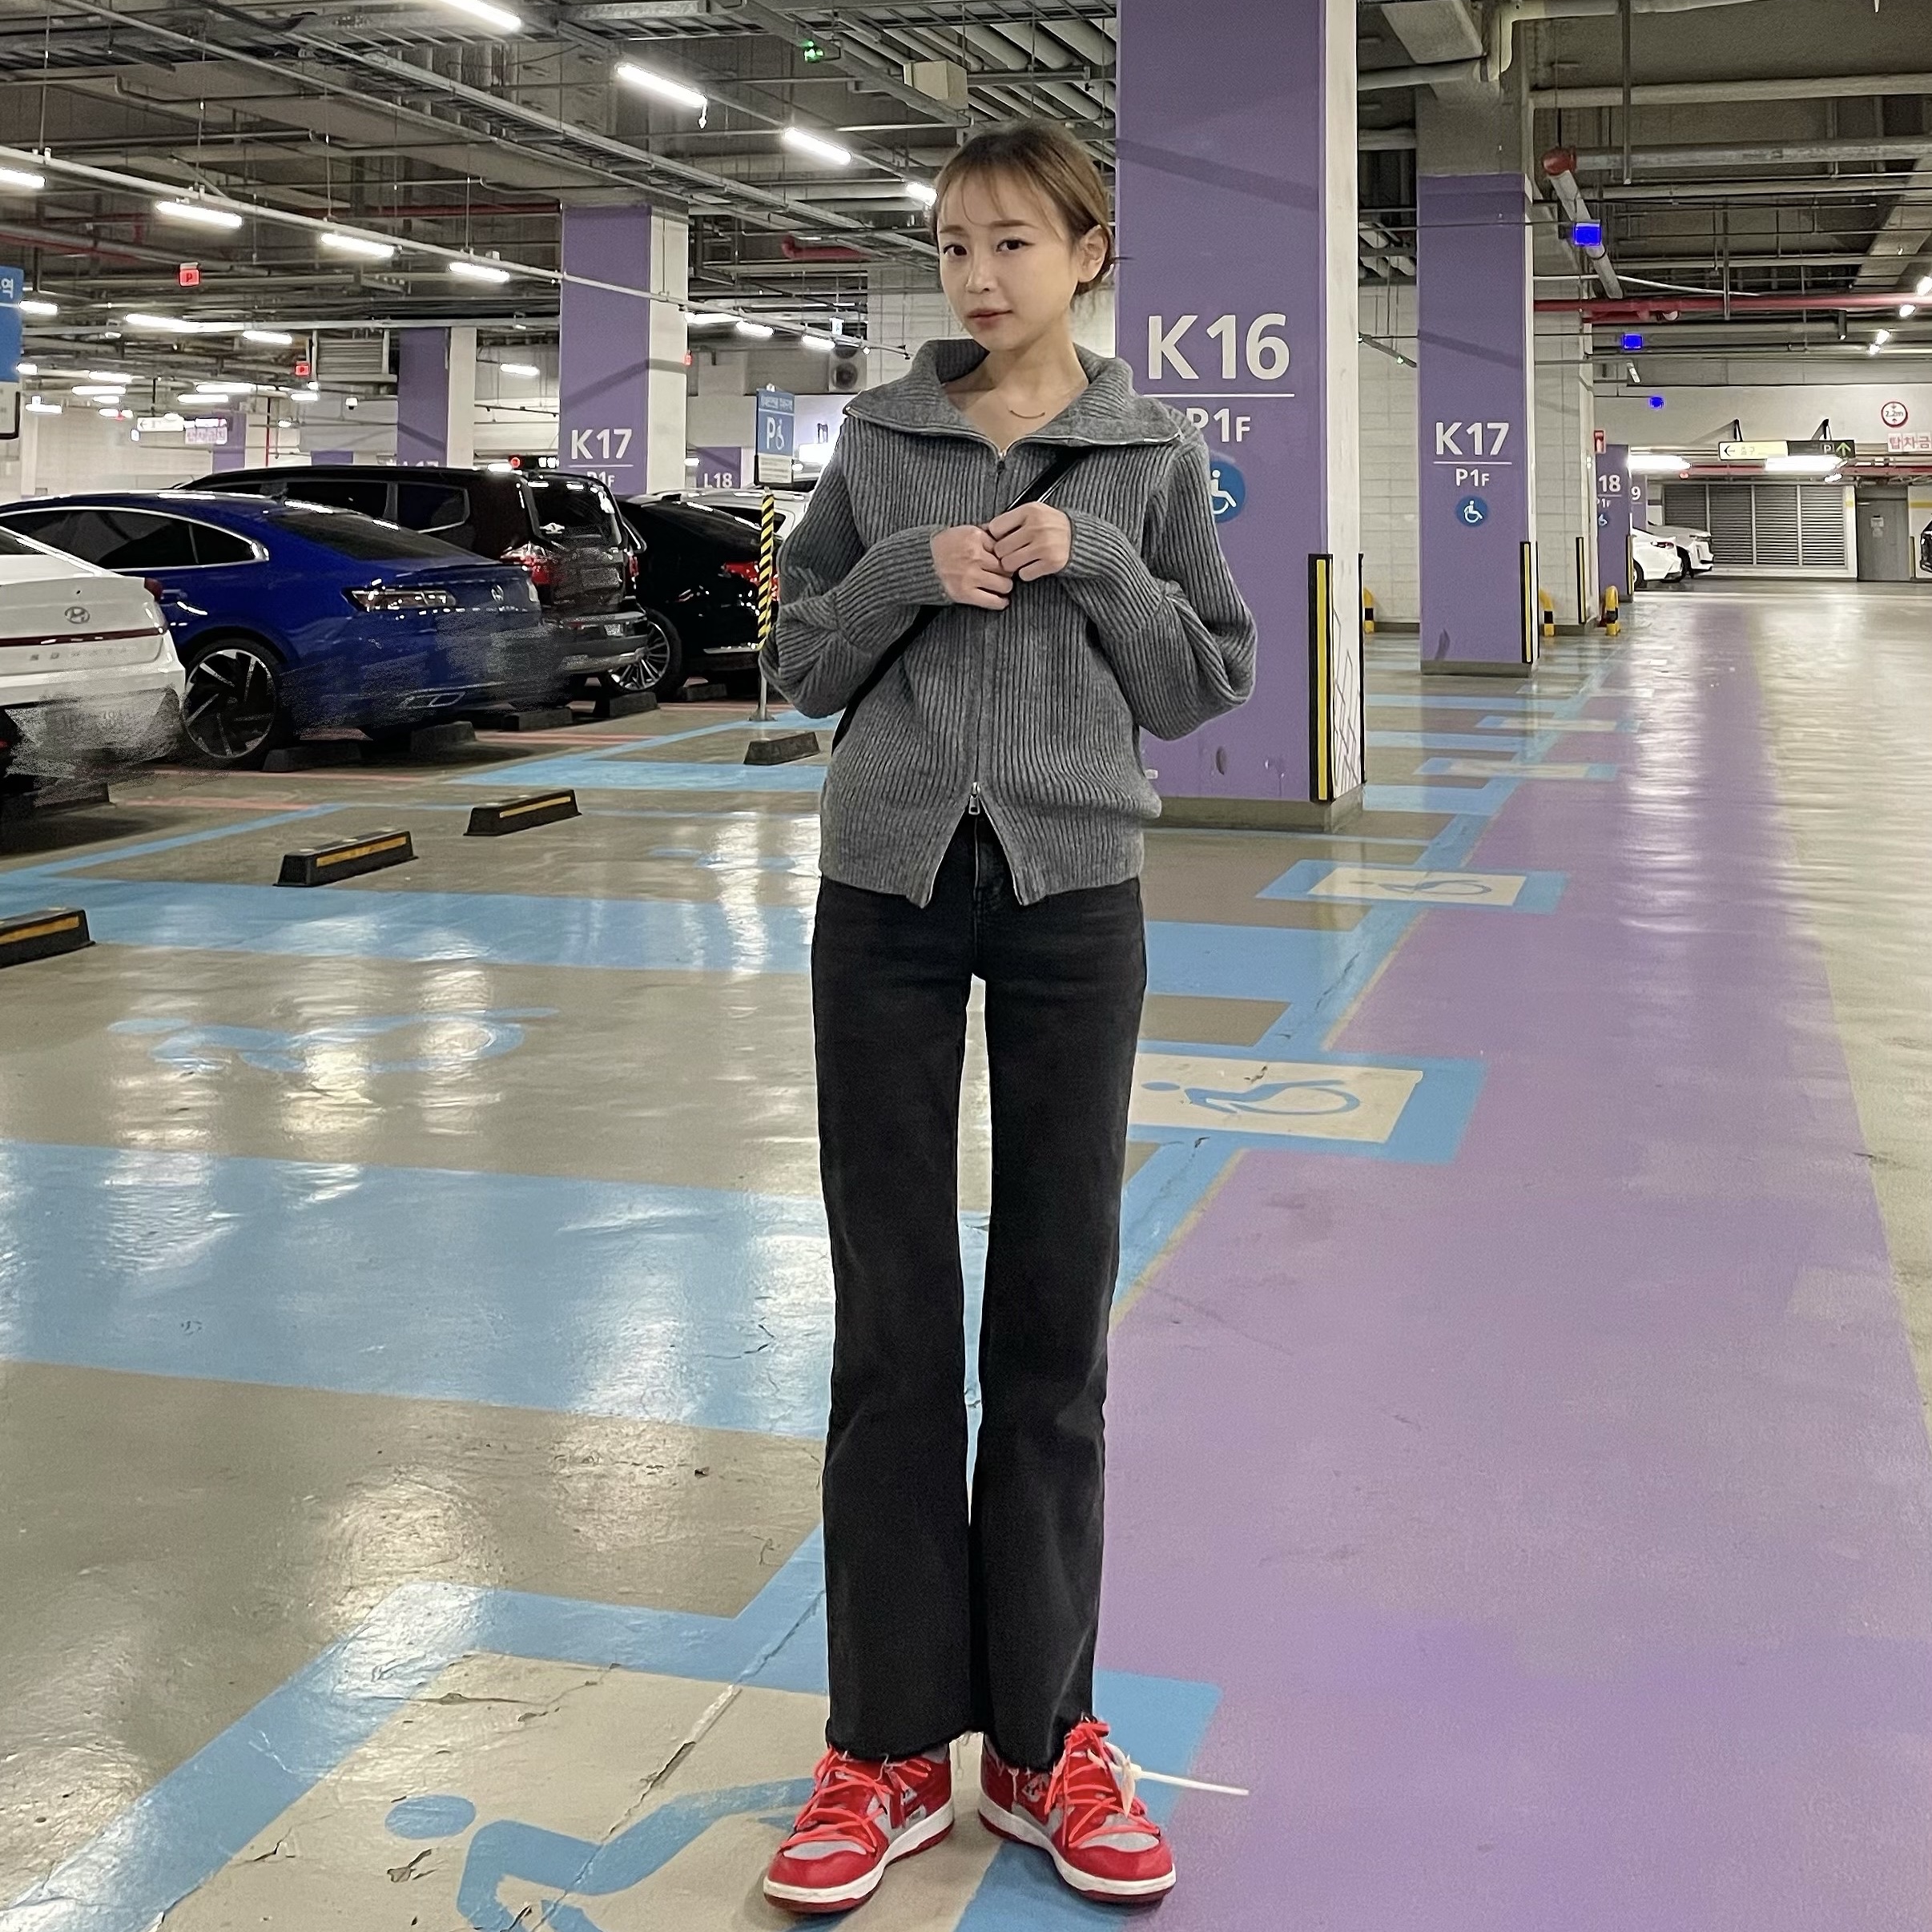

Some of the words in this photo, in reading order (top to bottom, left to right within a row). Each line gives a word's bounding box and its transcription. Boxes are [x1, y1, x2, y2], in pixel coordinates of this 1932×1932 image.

[1149, 313, 1290, 380] K16
[571, 428, 632, 460] K17
[1435, 421, 1509, 456] K17
[704, 472, 733, 489] L18
[1455, 468, 1490, 487] P1F
